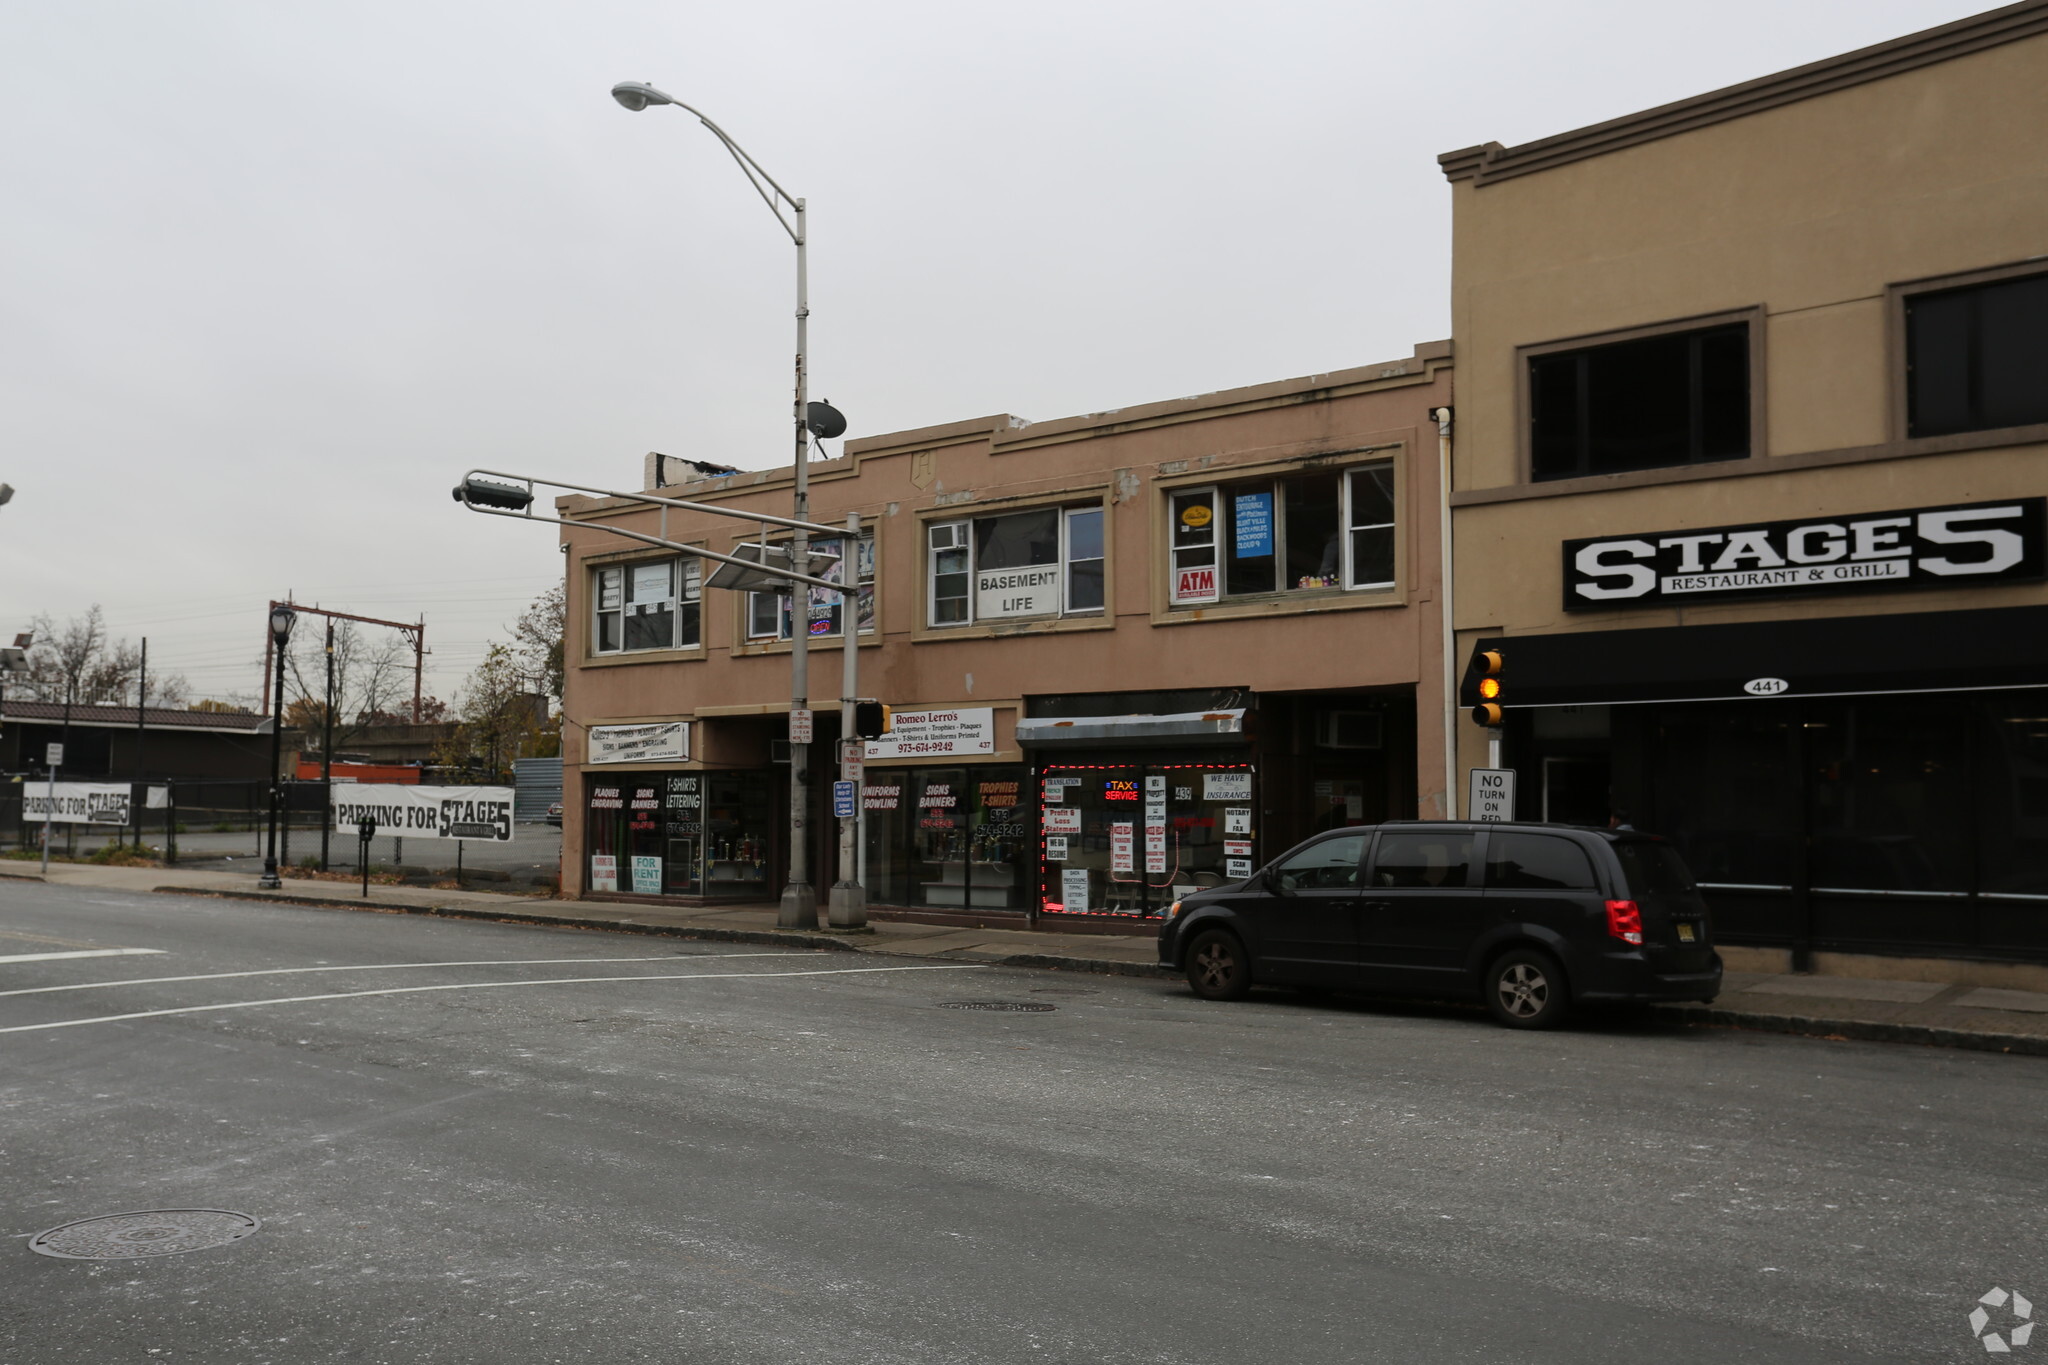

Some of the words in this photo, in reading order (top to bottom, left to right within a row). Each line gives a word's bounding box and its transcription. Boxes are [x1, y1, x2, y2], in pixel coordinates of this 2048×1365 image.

[980, 572, 1057, 591] BASEMENT
[1180, 571, 1214, 591] ATM
[1672, 570, 1799, 590] RESTAURANT
[1808, 568, 1824, 581] &
[1833, 563, 1897, 579] GRILL
[1003, 597, 1033, 612] LIFE
[1752, 681, 1780, 692] 441
[896, 714, 926, 725] Romeo
[928, 712, 958, 723] Lerro's
[897, 726, 927, 735] Equipment
[932, 723, 956, 732] Trophies
[898, 742, 953, 753] 973-674-9242
[1047, 778, 1079, 786] TRANSLATION
[1224, 774, 1245, 782] HAVE
[1482, 775, 1503, 788] NO
[667, 778, 697, 792] T-SHIRTS
[926, 785, 950, 795] SIGNS
[979, 782, 1019, 793] TROPHIES
[1110, 780, 1133, 790] TAX
[594, 788, 620, 798] PLAQUES
[636, 789, 655, 798] SIGNS
[862, 786, 900, 796] UNIFORMS
[1105, 791, 1139, 800] SERVICE
[1176, 788, 1191, 799] 439
[1206, 791, 1251, 799] INSURANCE
[1479, 790, 1505, 800] TURN
[591, 799, 623, 808] ENGRAVING
[630, 800, 659, 809] BANNERS
[666, 794, 700, 808] LETTERING
[864, 798, 898, 808] BOWLING
[919, 797, 957, 807] BANNERS
[980, 795, 1017, 806] T-SHIRTS
[67, 798, 87, 816] FOR
[1484, 802, 1499, 811] ON
[407, 806, 437, 829] FOR
[990, 809, 1010, 822] 973
[1481, 814, 1501, 822] RED
[666, 822, 701, 833] 674-9242
[976, 824, 1024, 836] 674-9242
[1048, 850, 1066, 858] RESUME
[637, 858, 656, 868] FOR
[634, 869, 660, 879] RENT
[1229, 869, 1249, 877] SERVICE
